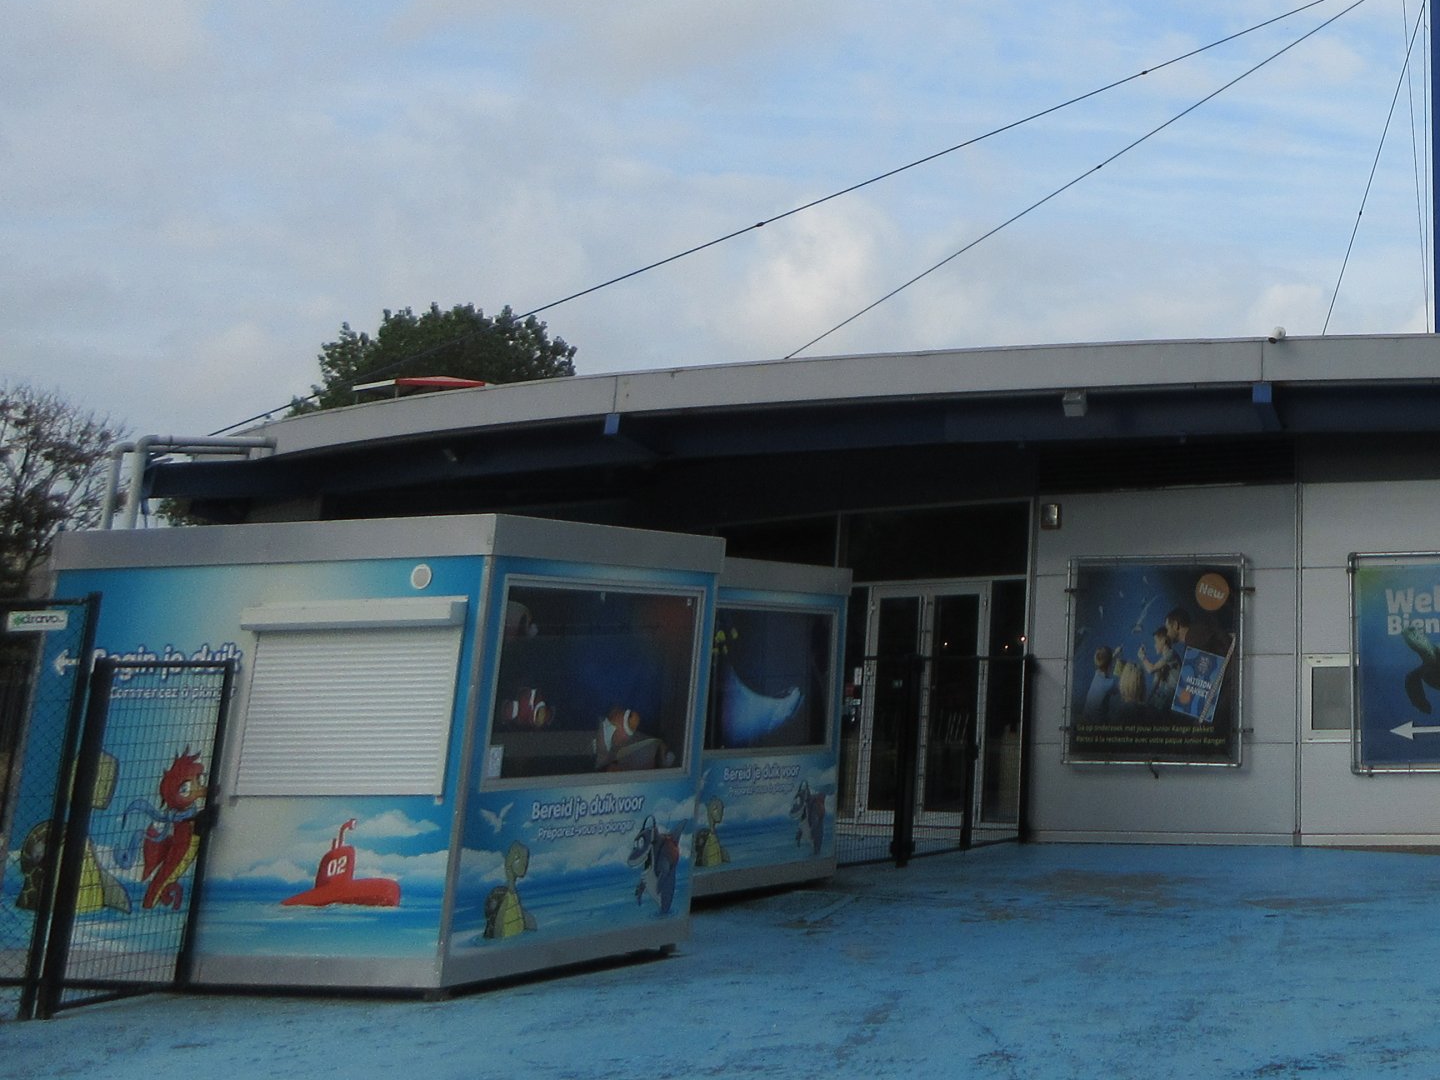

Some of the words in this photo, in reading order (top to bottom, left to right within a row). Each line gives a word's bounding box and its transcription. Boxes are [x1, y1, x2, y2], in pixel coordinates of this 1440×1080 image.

[1199, 582, 1224, 600] New
[192, 685, 237, 701] plongr
[532, 798, 572, 820] Bereid
[574, 797, 587, 820] je
[590, 793, 616, 815] duik
[617, 796, 645, 813] voor
[327, 855, 347, 877] 02
